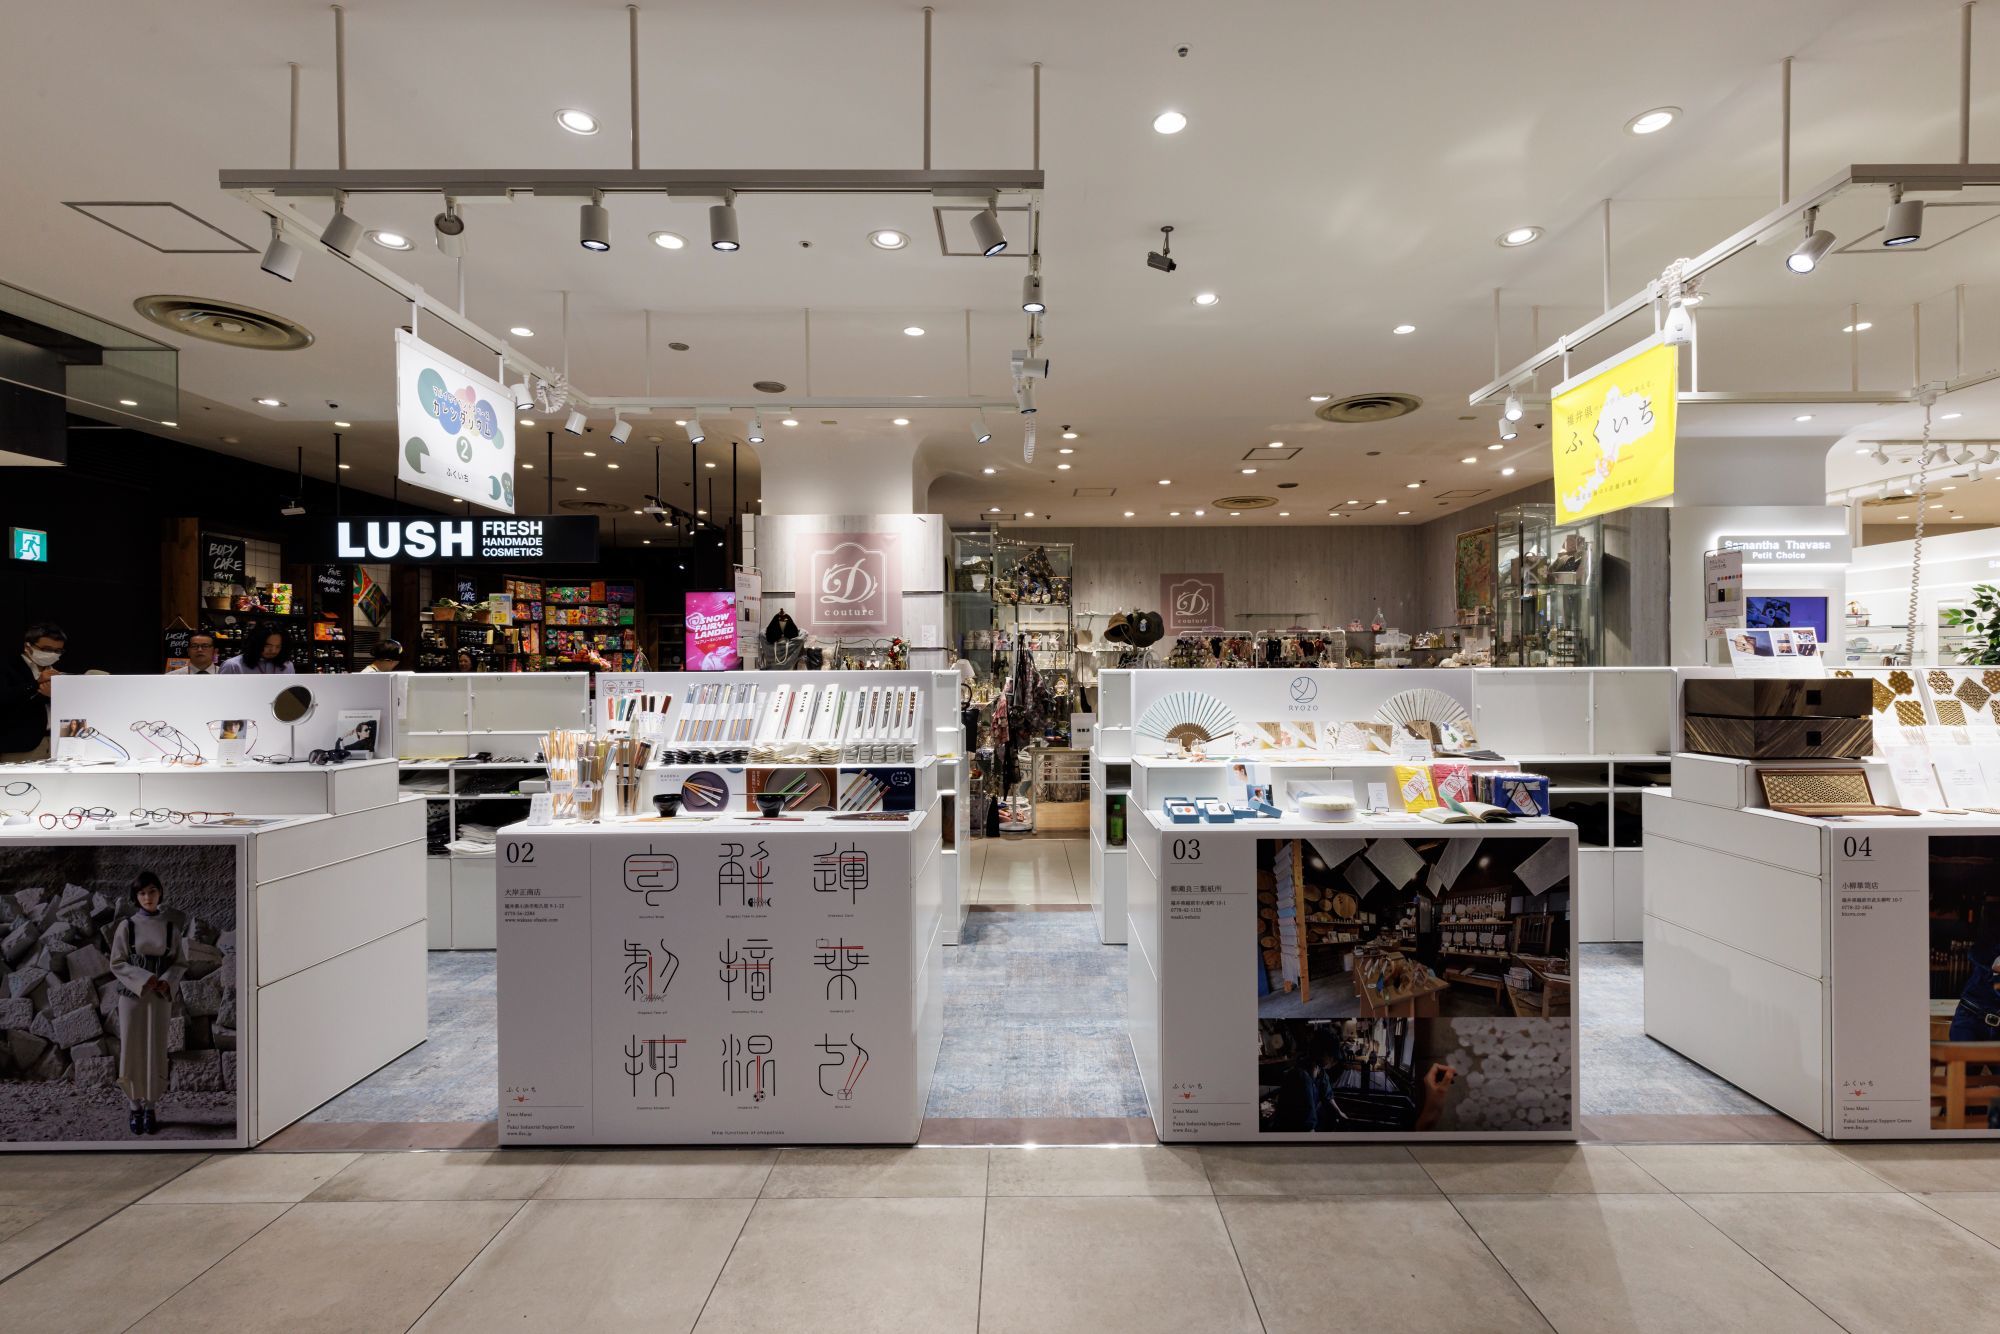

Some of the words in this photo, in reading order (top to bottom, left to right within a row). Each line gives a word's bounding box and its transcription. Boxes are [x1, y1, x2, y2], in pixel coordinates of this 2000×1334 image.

[1566, 399, 1654, 454] ふくいち
[460, 439, 469, 460] 2
[446, 468, 469, 483] ふくいち
[482, 521, 542, 535] FRESH
[338, 521, 473, 558] LUSH
[482, 538, 542, 546] HANDMADE
[1725, 541, 1779, 550] Samantha
[1786, 540, 1831, 550] Thavasa
[209, 543, 238, 557] BODY
[482, 547, 543, 557] COSMETICS
[1752, 551, 1772, 560] Petit
[1776, 551, 1805, 560] Choice
[213, 558, 242, 571] CARE
[460, 592, 475, 602] CARE
[699, 613, 729, 624] SNOW
[824, 608, 875, 616] couture
[695, 621, 725, 632] FAIRY
[695, 627, 734, 640] LANDED
[506, 842, 534, 863] 02
[1173, 838, 1201, 860] 03
[1843, 836, 1872, 858] 04
